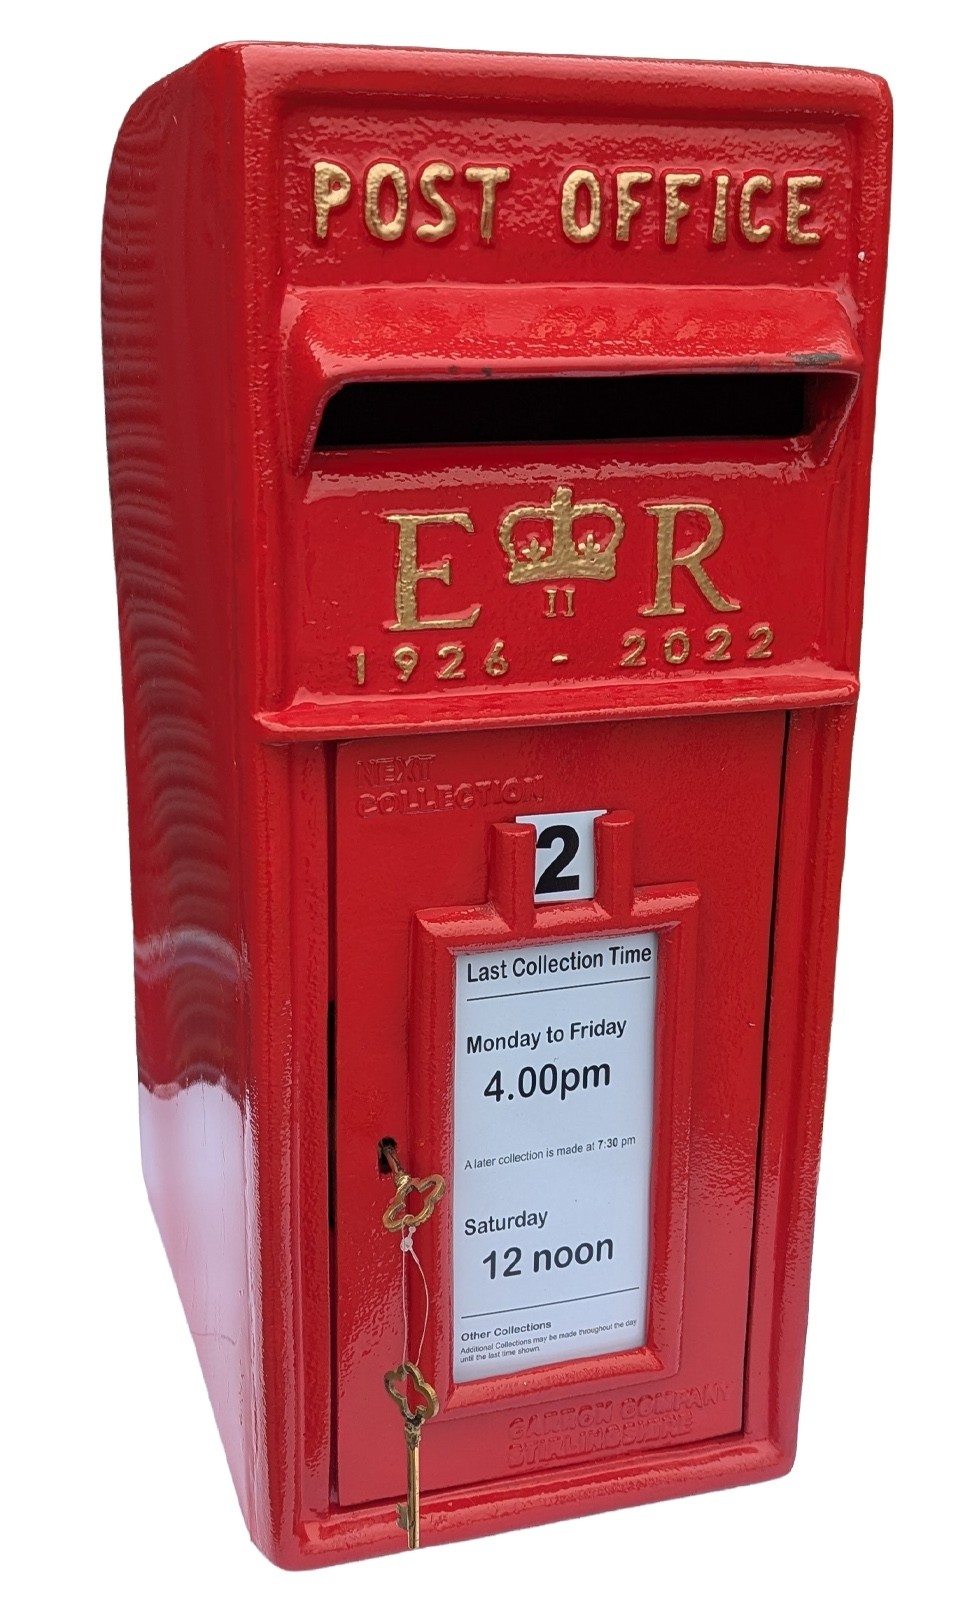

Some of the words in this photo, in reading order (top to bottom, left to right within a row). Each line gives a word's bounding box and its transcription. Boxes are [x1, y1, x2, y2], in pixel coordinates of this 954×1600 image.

[313, 161, 510, 244] POST
[560, 168, 824, 245] OFFICE
[383, 510, 481, 632] E
[640, 503, 741, 617] R
[351, 640, 509, 685] 1926
[620, 626, 775, 667] 2022
[355, 753, 436, 787] NEXT
[355, 774, 545, 818] COLLECTION
[535, 825, 580, 895] 2
[467, 959, 507, 983] Last
[512, 950, 603, 978] Collection
[608, 945, 652, 966] Time
[466, 1030, 541, 1054] Monday
[546, 1026, 564, 1044] to
[570, 1018, 627, 1041] Friday
[483, 1062, 611, 1102] 4.00pm
[464, 1160, 472, 1171] A
[474, 1157, 497, 1169] later
[498, 1149, 544, 1166] collection
[546, 1147, 554, 1158] is
[556, 1144, 584, 1156] made
[586, 1141, 595, 1152] at
[597, 1137, 618, 1150] 7:30
[621, 1135, 636, 1149] pm
[464, 1210, 549, 1236] Saturday
[482, 1246, 522, 1280] 12
[533, 1238, 614, 1273] noon
[460, 1328, 492, 1342] Other
[493, 1320, 552, 1337] Collections
[460, 1343, 493, 1355] Additional
[495, 1337, 532, 1350] Collections
[533, 1335, 548, 1345] may
[549, 1333, 558, 1341] be
[558, 1330, 577, 1339] made
[578, 1323, 613, 1336] throughout
[613, 1321, 624, 1330] the
[625, 1318, 637, 1328] day
[460, 1353, 475, 1363] until
[476, 1352, 487, 1361] the
[488, 1350, 501, 1359] last
[502, 1348, 516, 1357] time
